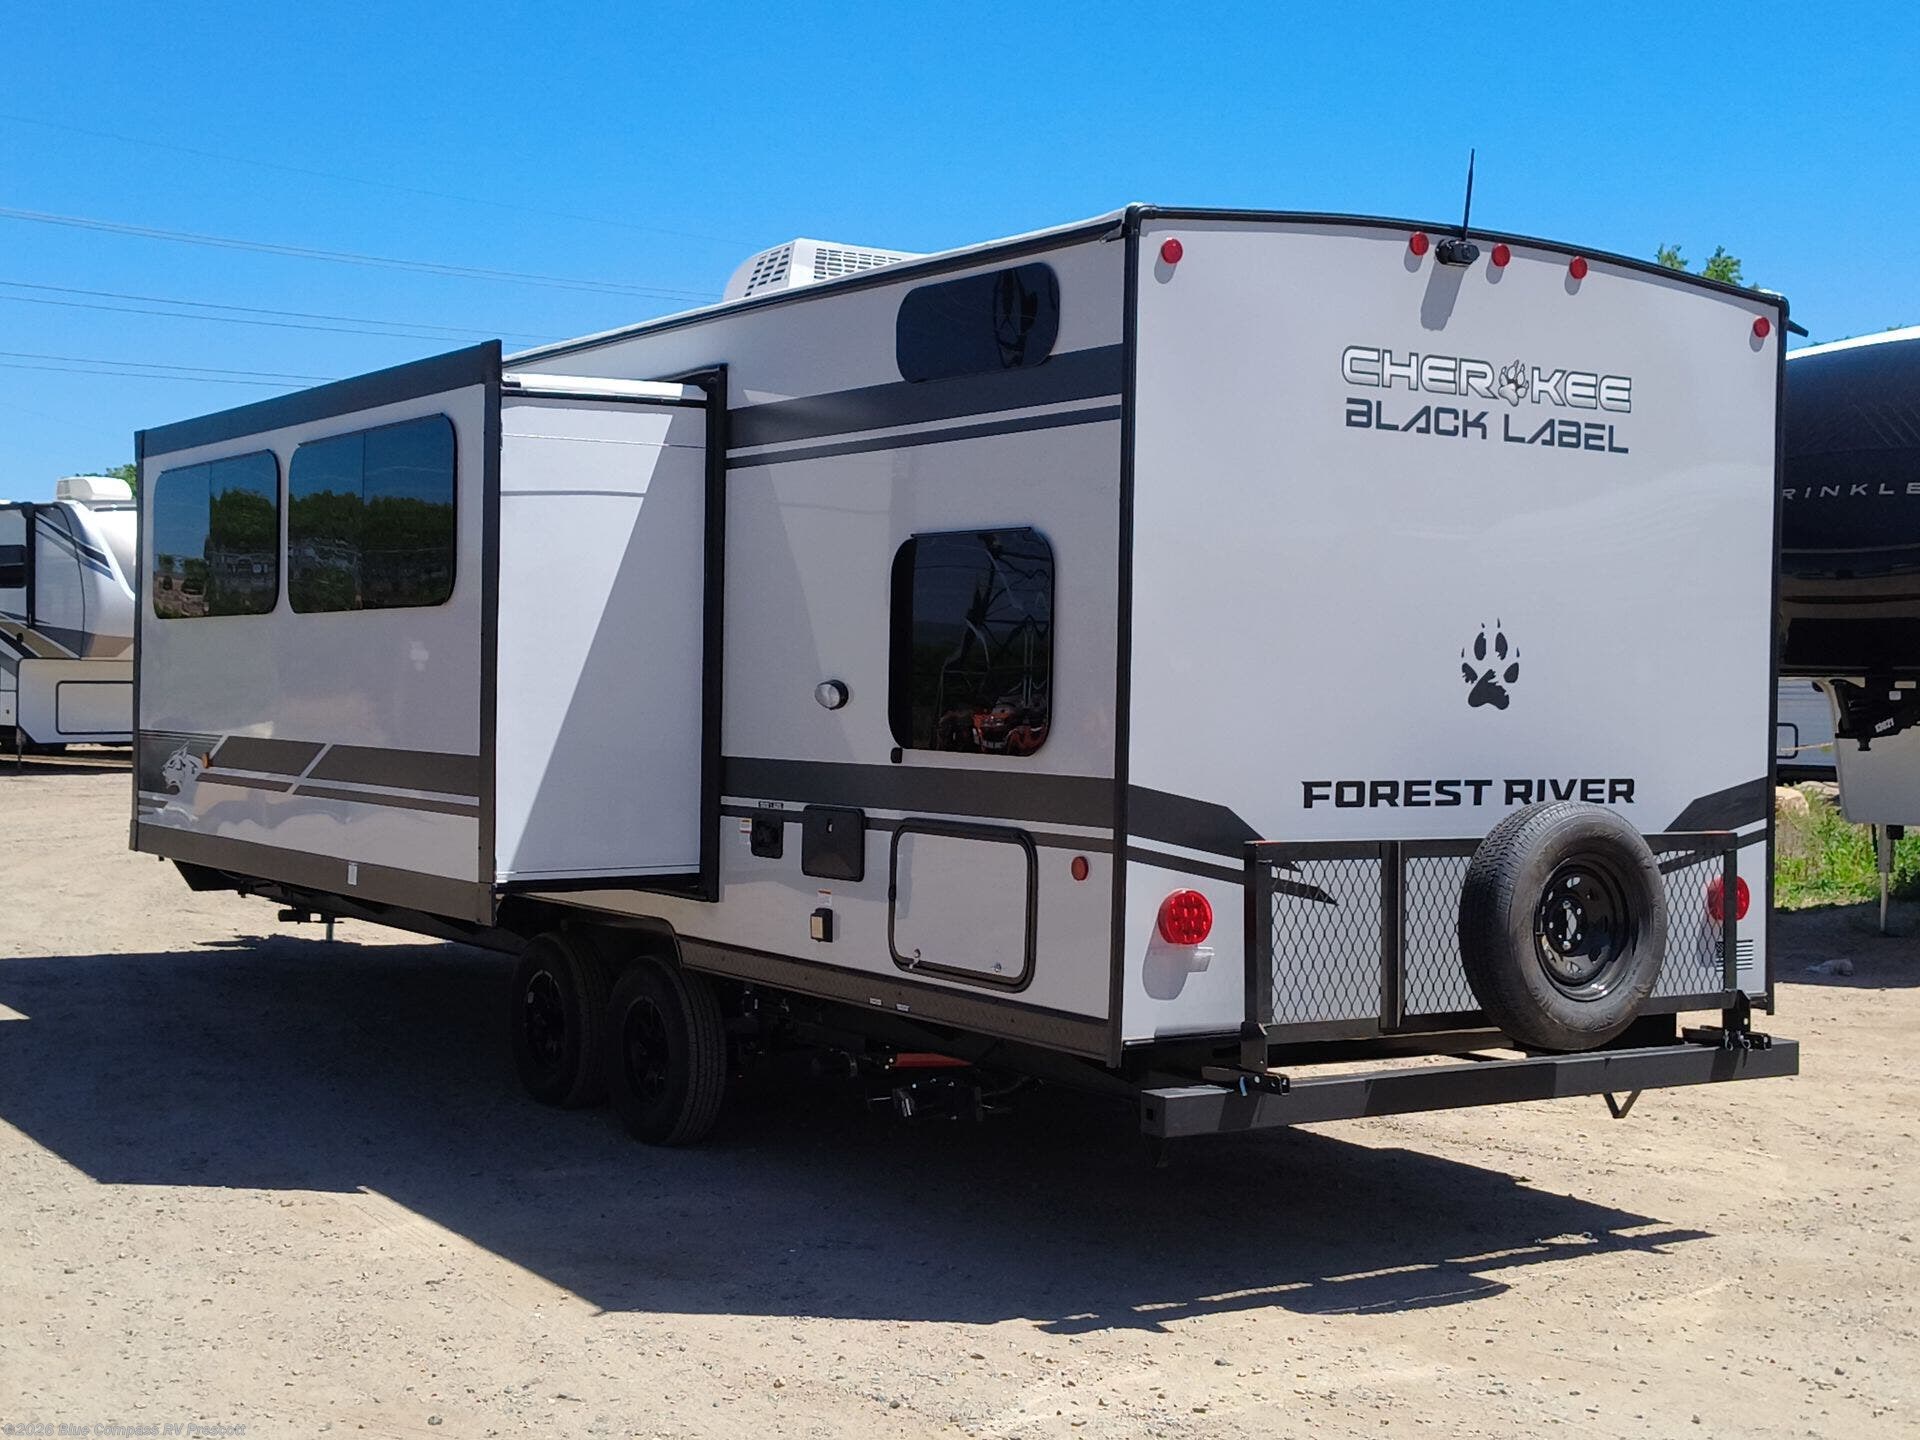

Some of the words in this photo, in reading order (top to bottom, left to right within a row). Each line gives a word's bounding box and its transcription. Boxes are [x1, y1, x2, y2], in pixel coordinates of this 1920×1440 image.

[1345, 397, 1489, 440] BLACK
[1503, 414, 1630, 454] LABEL
[1301, 779, 1493, 808] FOREST
[1503, 778, 1636, 805] RIVER
